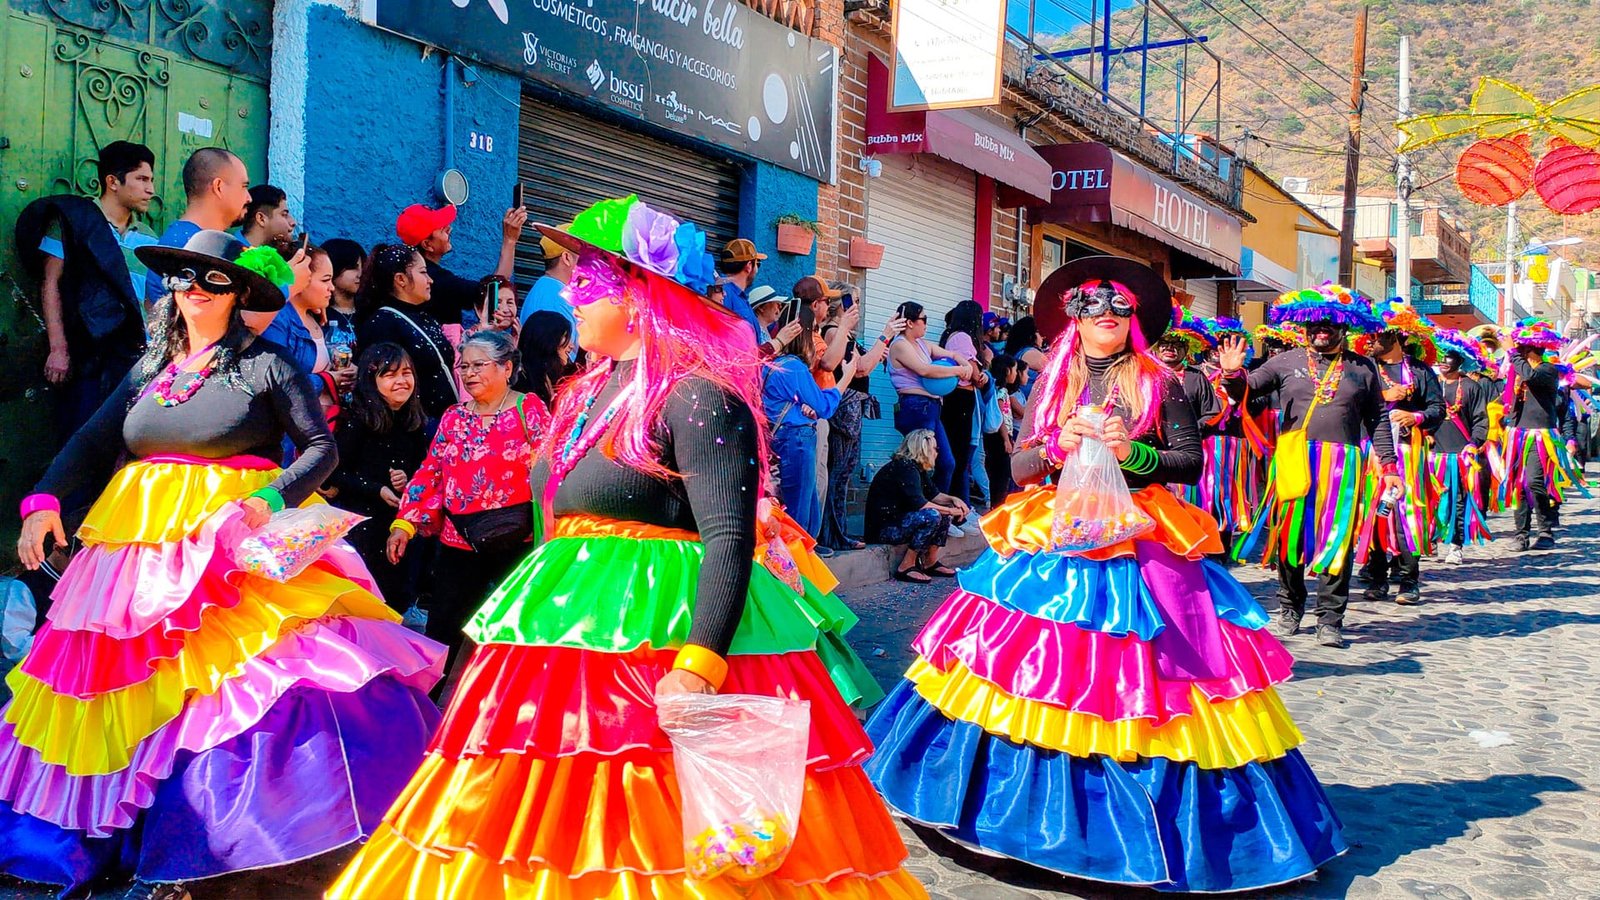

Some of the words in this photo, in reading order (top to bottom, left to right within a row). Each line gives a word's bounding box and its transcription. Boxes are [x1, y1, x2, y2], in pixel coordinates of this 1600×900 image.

[702, 0, 745, 50] bella
[539, 44, 577, 68] VICTORIA'S
[546, 58, 571, 75] SECRET
[867, 134, 899, 145] Bubba
[901, 132, 923, 144] Mix
[974, 132, 999, 153] Bubba
[999, 143, 1015, 162] Mix
[1051, 168, 1109, 192] OTEL
[1152, 183, 1211, 248] HOTEL
